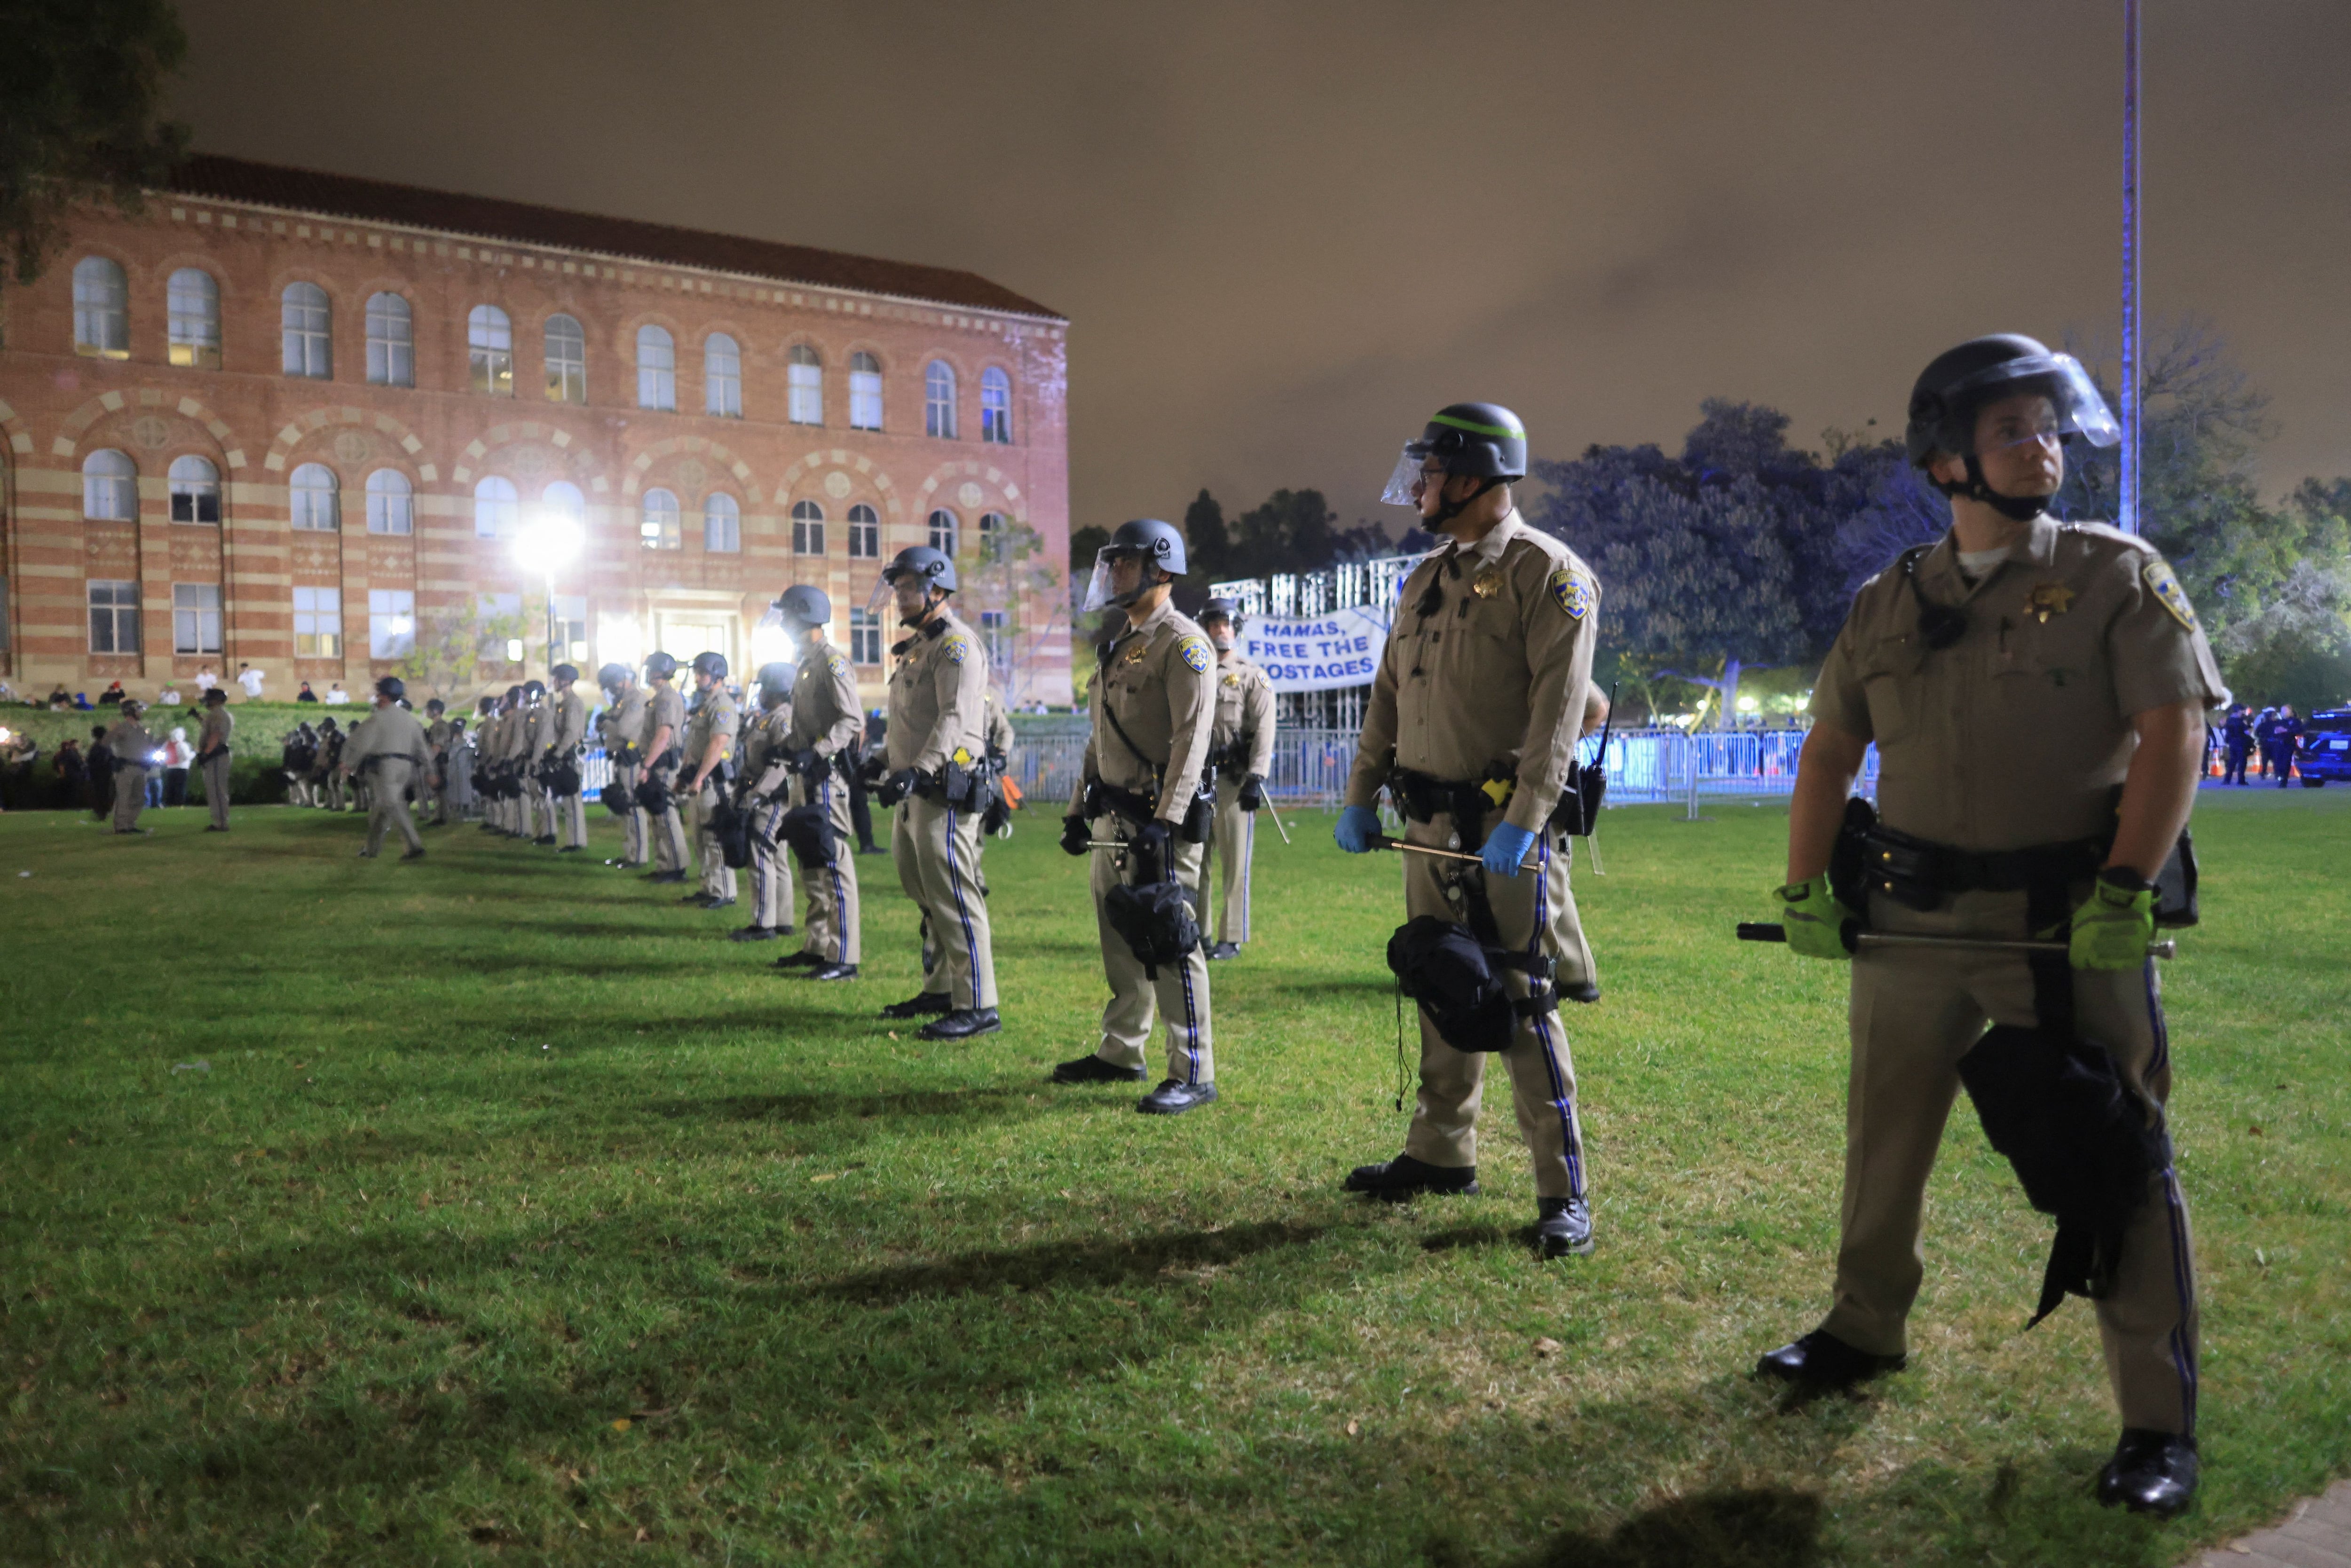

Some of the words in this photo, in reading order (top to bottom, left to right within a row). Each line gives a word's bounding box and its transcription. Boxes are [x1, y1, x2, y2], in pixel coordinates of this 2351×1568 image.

[1263, 621, 1346, 637] HAMAS,
[1248, 640, 1309, 658] FREE
[1317, 636, 1369, 658] THE
[1260, 657, 1374, 680] OSTAGES
